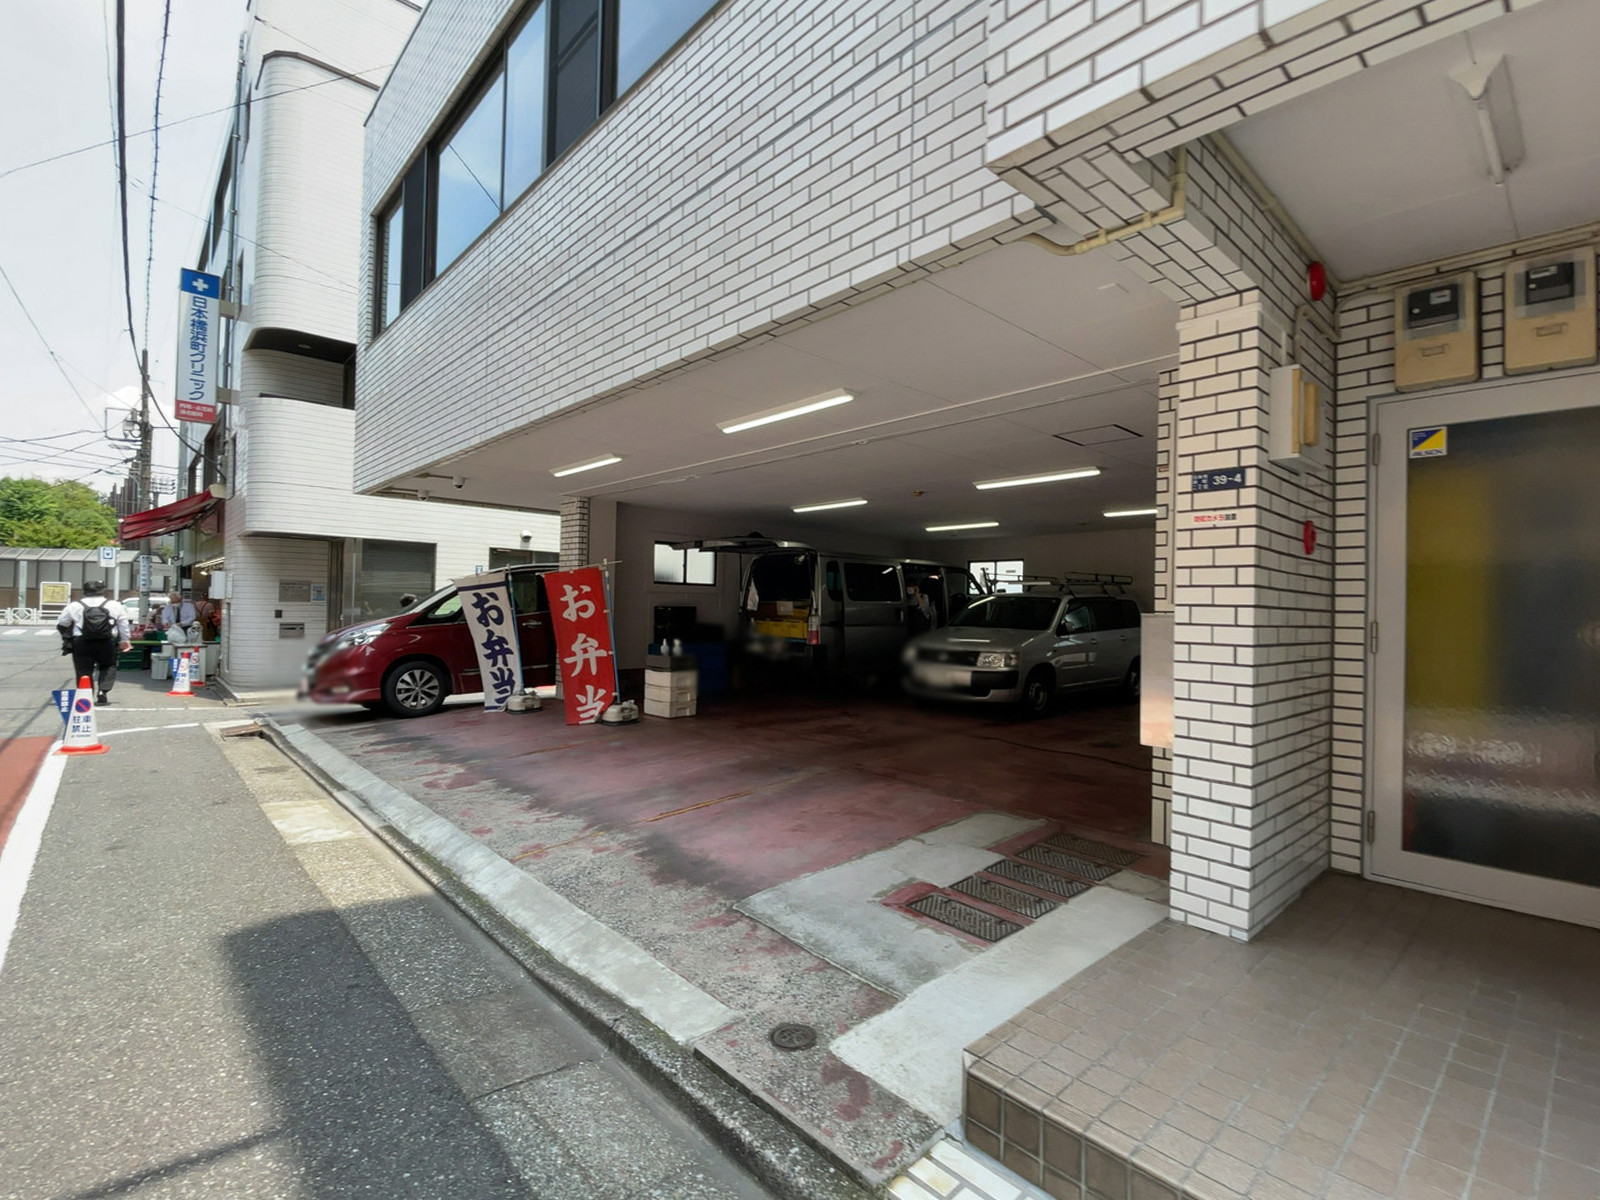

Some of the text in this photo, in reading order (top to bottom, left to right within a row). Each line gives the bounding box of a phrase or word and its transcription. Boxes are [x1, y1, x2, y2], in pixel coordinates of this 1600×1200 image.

[1212, 473, 1242, 485] 39-4
[471, 591, 515, 704] お弁当
[560, 584, 608, 724] お弁当
